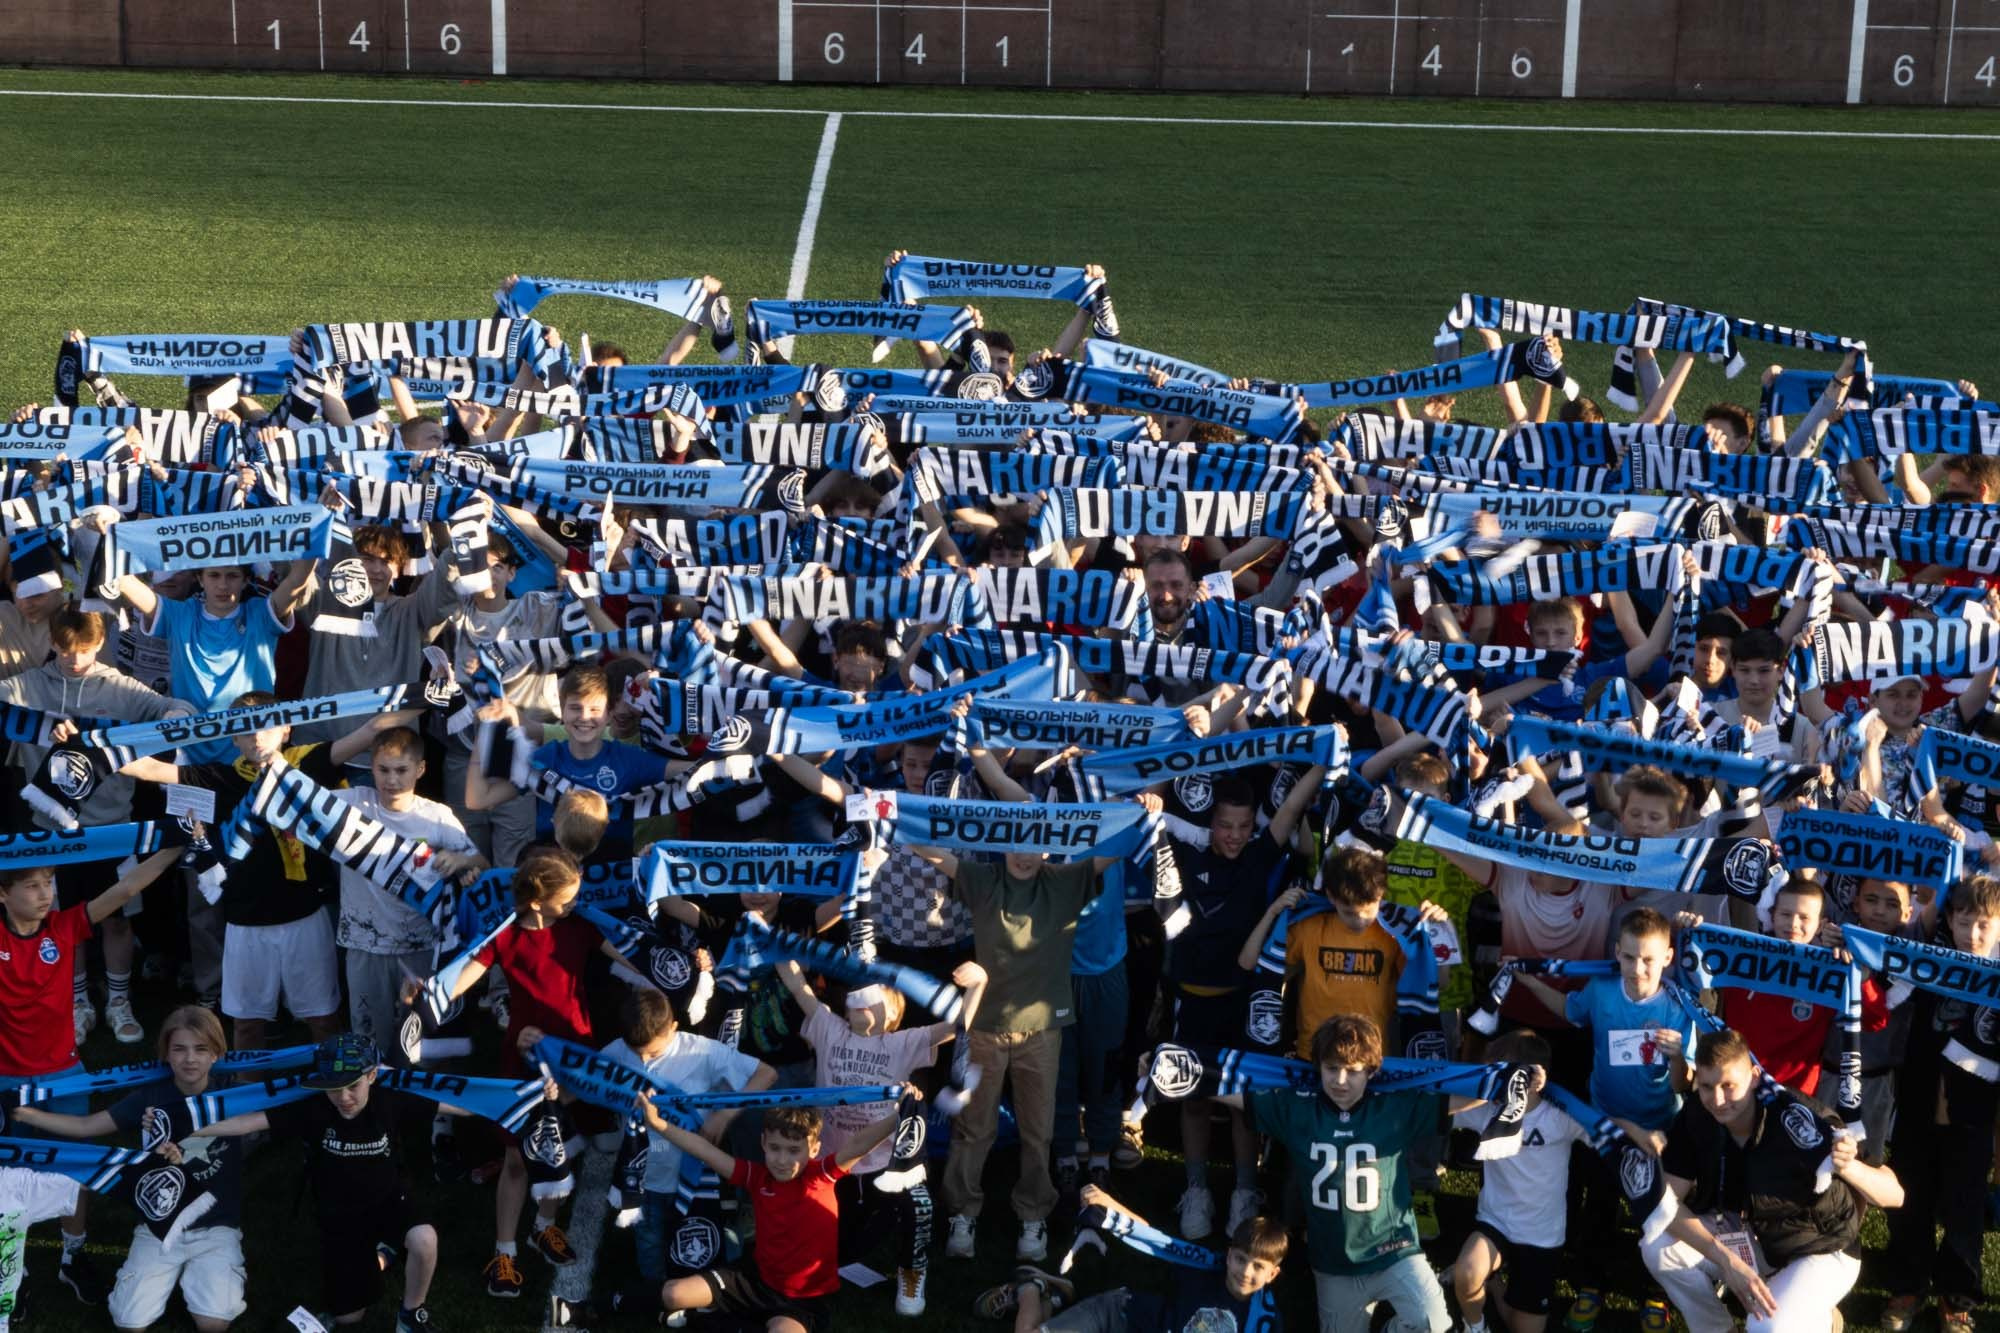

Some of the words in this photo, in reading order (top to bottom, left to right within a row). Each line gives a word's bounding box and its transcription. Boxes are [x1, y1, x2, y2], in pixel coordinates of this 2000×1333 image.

[266, 20, 281, 50] 1
[348, 22, 371, 52] 4
[440, 24, 461, 56] 6
[823, 33, 845, 64] 6
[904, 34, 927, 65] 4
[996, 35, 1008, 67] 1
[1420, 45, 1443, 76] 4
[1510, 48, 1532, 78] 6
[1892, 55, 1914, 86] 6
[1974, 56, 1997, 87] 4
[928, 279, 960, 289] КЛУБ
[793, 310, 922, 332] РОДИНА
[126, 341, 266, 357] РОДИНА
[349, 318, 511, 362] NAROD
[130, 357, 165, 367] КЛУБ
[171, 357, 263, 369] ФУТБОЛЬНЫЙ
[409, 382, 443, 393] КЛУБ
[1331, 364, 1461, 399] РОДИНА
[1116, 388, 1253, 428] РОДИНА
[1219, 390, 1256, 406] КЛУБ
[957, 428, 994, 438] КЛУБ
[1871, 408, 2000, 456] AROD
[565, 475, 709, 499] РОДИНА
[566, 465, 664, 479] ФУТБОЛЬНЫЙ
[673, 469, 711, 480] КЛУБ
[919, 446, 1087, 497] NAROD
[1078, 488, 1252, 537] NAROD
[1480, 497, 1631, 518] РОДИНА
[157, 514, 264, 537] ФУТБОЛЬНЫЙ
[272, 512, 312, 527] КЛУБ
[160, 528, 311, 562] РОДИНА
[782, 575, 957, 626] NAROD
[977, 567, 1145, 630] NAROD
[1827, 617, 2000, 683] NAROD
[1325, 653, 1466, 749] NAROD
[163, 701, 338, 743] РОДИНА
[978, 707, 1100, 724] ФУТБОЛЬНЫЙ
[1107, 713, 1154, 728] КЛУБ
[983, 720, 1151, 749] РОДИНА
[1134, 730, 1317, 779] РОДИНА
[928, 804, 1048, 821] ФУТБОЛЬНЫЙ
[1056, 809, 1103, 822] КЛУБ
[929, 819, 1098, 847] РОДИНА
[1908, 833, 1952, 857] КЛУБ
[666, 844, 789, 858] ФУТБОЛЬНЫЙ
[1779, 835, 1947, 878] РОДИНА
[672, 860, 842, 888] РОДИНА
[1884, 935, 2000, 968] ФУТБОЛЬНЫ
[1882, 950, 2000, 998] РОДИ
[1310, 1142, 1380, 1212] 26
